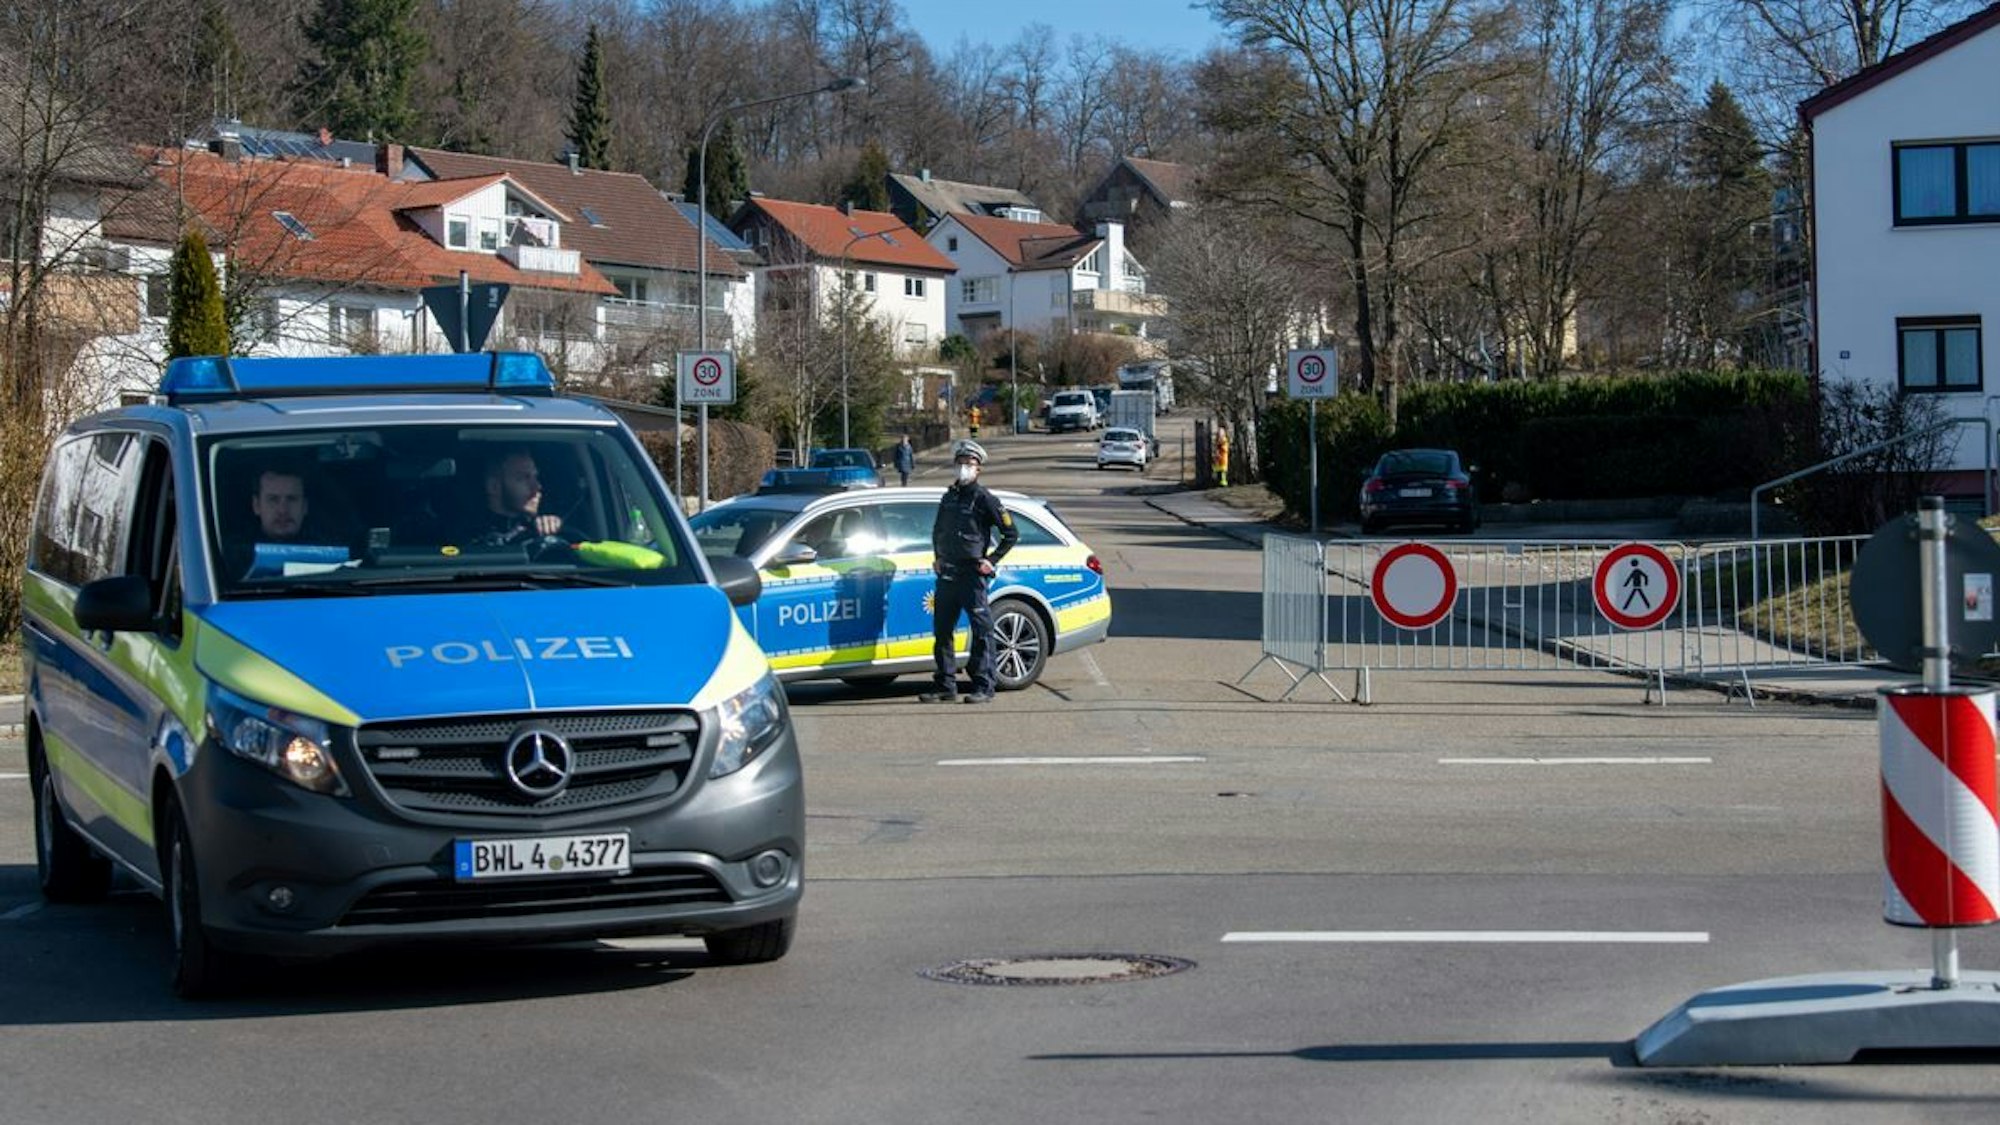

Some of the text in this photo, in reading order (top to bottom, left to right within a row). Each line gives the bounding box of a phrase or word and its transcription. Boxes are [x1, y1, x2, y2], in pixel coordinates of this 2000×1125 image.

[699, 365, 716, 378] 30
[1303, 362, 1320, 376] 30
[694, 388, 721, 398] ZONE
[1300, 385, 1323, 394] ZONE
[779, 598, 861, 627] POLIZEI
[385, 636, 634, 668] POLIZEI
[475, 844, 523, 872] BWL
[531, 843, 545, 870] 4
[566, 838, 625, 867] 4377
